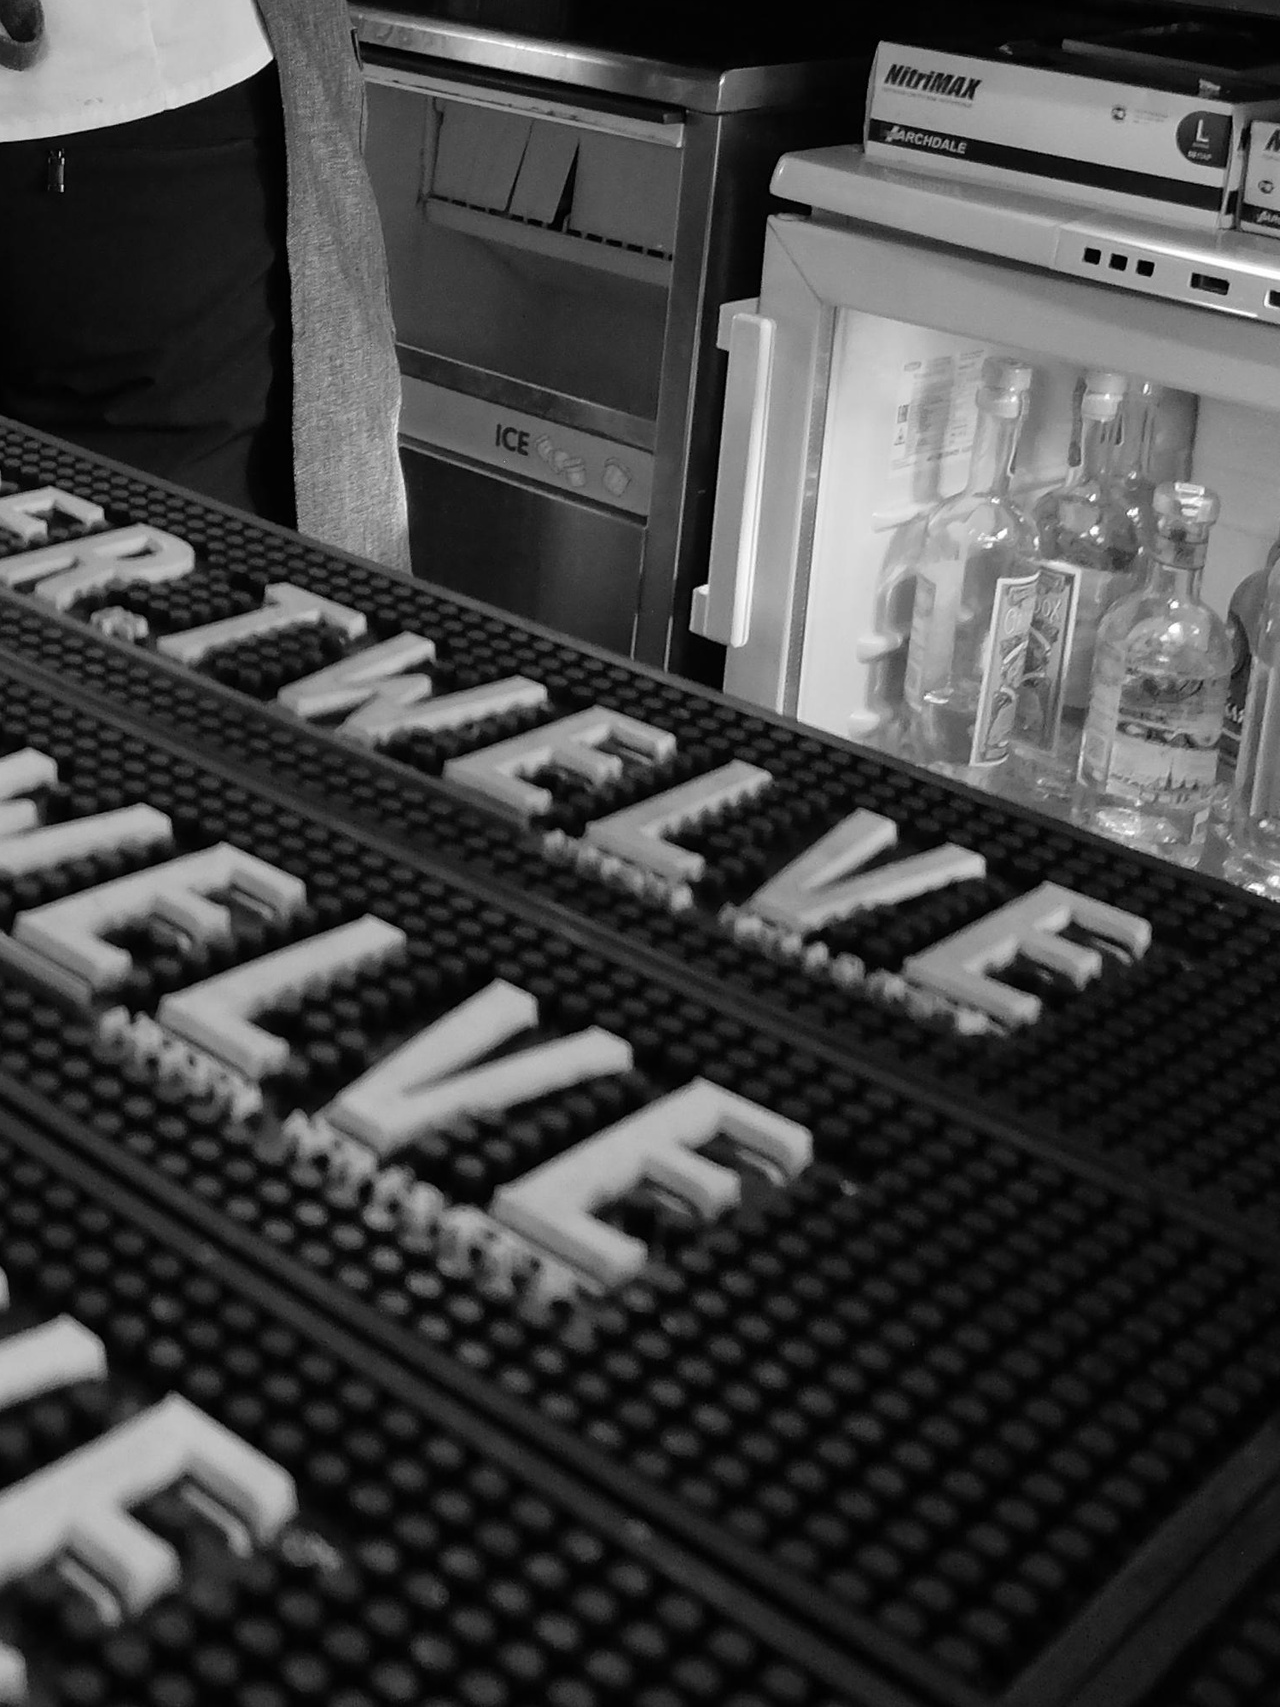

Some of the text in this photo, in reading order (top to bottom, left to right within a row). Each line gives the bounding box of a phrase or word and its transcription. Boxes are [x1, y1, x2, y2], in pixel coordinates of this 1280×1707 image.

[883, 63, 983, 101] NitriMAX
[895, 129, 968, 155] ARCHDALE
[1195, 118, 1210, 143] L
[495, 424, 530, 457] ICE
[157, 581, 1153, 1026] TWELVE
